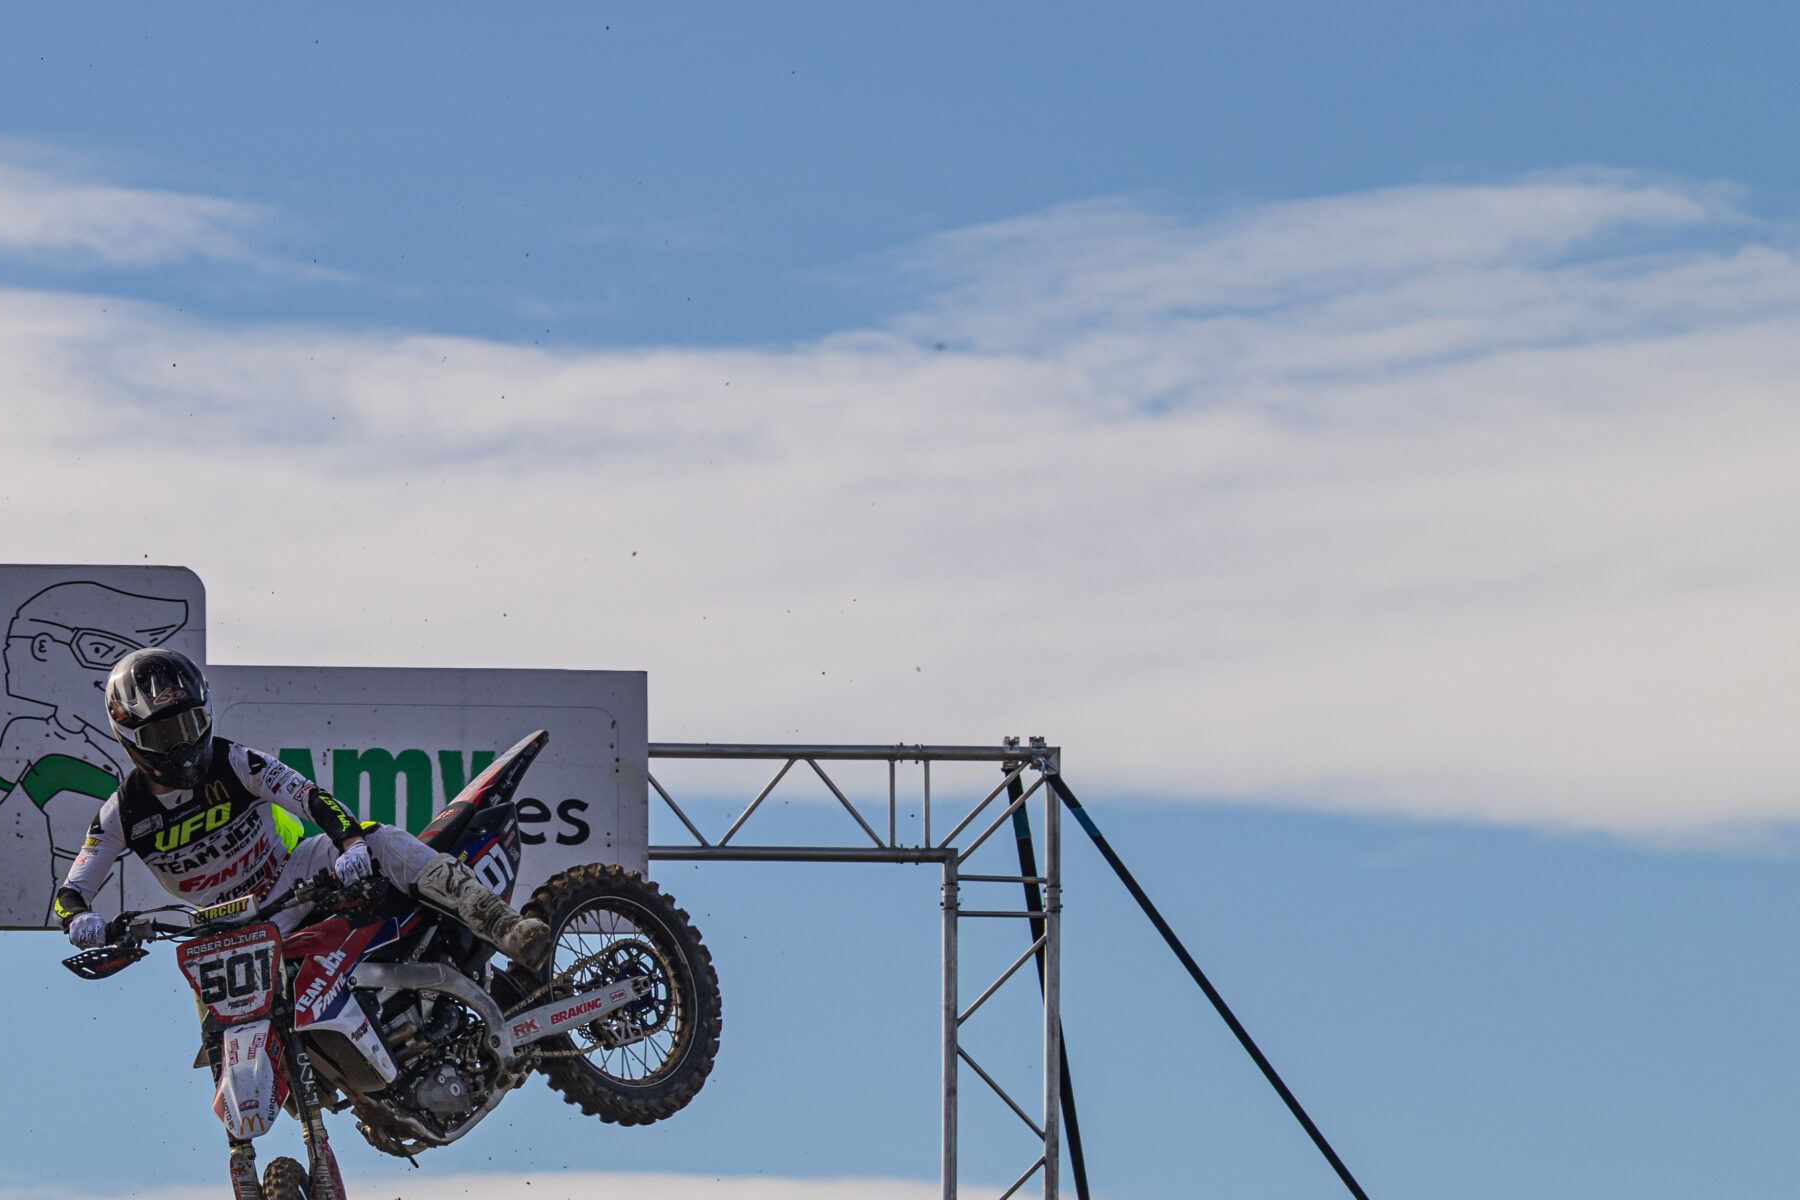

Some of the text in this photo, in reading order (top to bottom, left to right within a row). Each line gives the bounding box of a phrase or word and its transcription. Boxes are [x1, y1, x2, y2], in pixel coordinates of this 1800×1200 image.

[155, 802, 232, 852] UFO
[153, 845, 221, 875] TEAM
[178, 832, 270, 893] FANTIC
[223, 930, 267, 947] OLIVER
[200, 948, 272, 1004] 501
[295, 977, 328, 1013] TEAM
[550, 998, 602, 1025] BRAKING
[512, 1019, 539, 1037] RK
